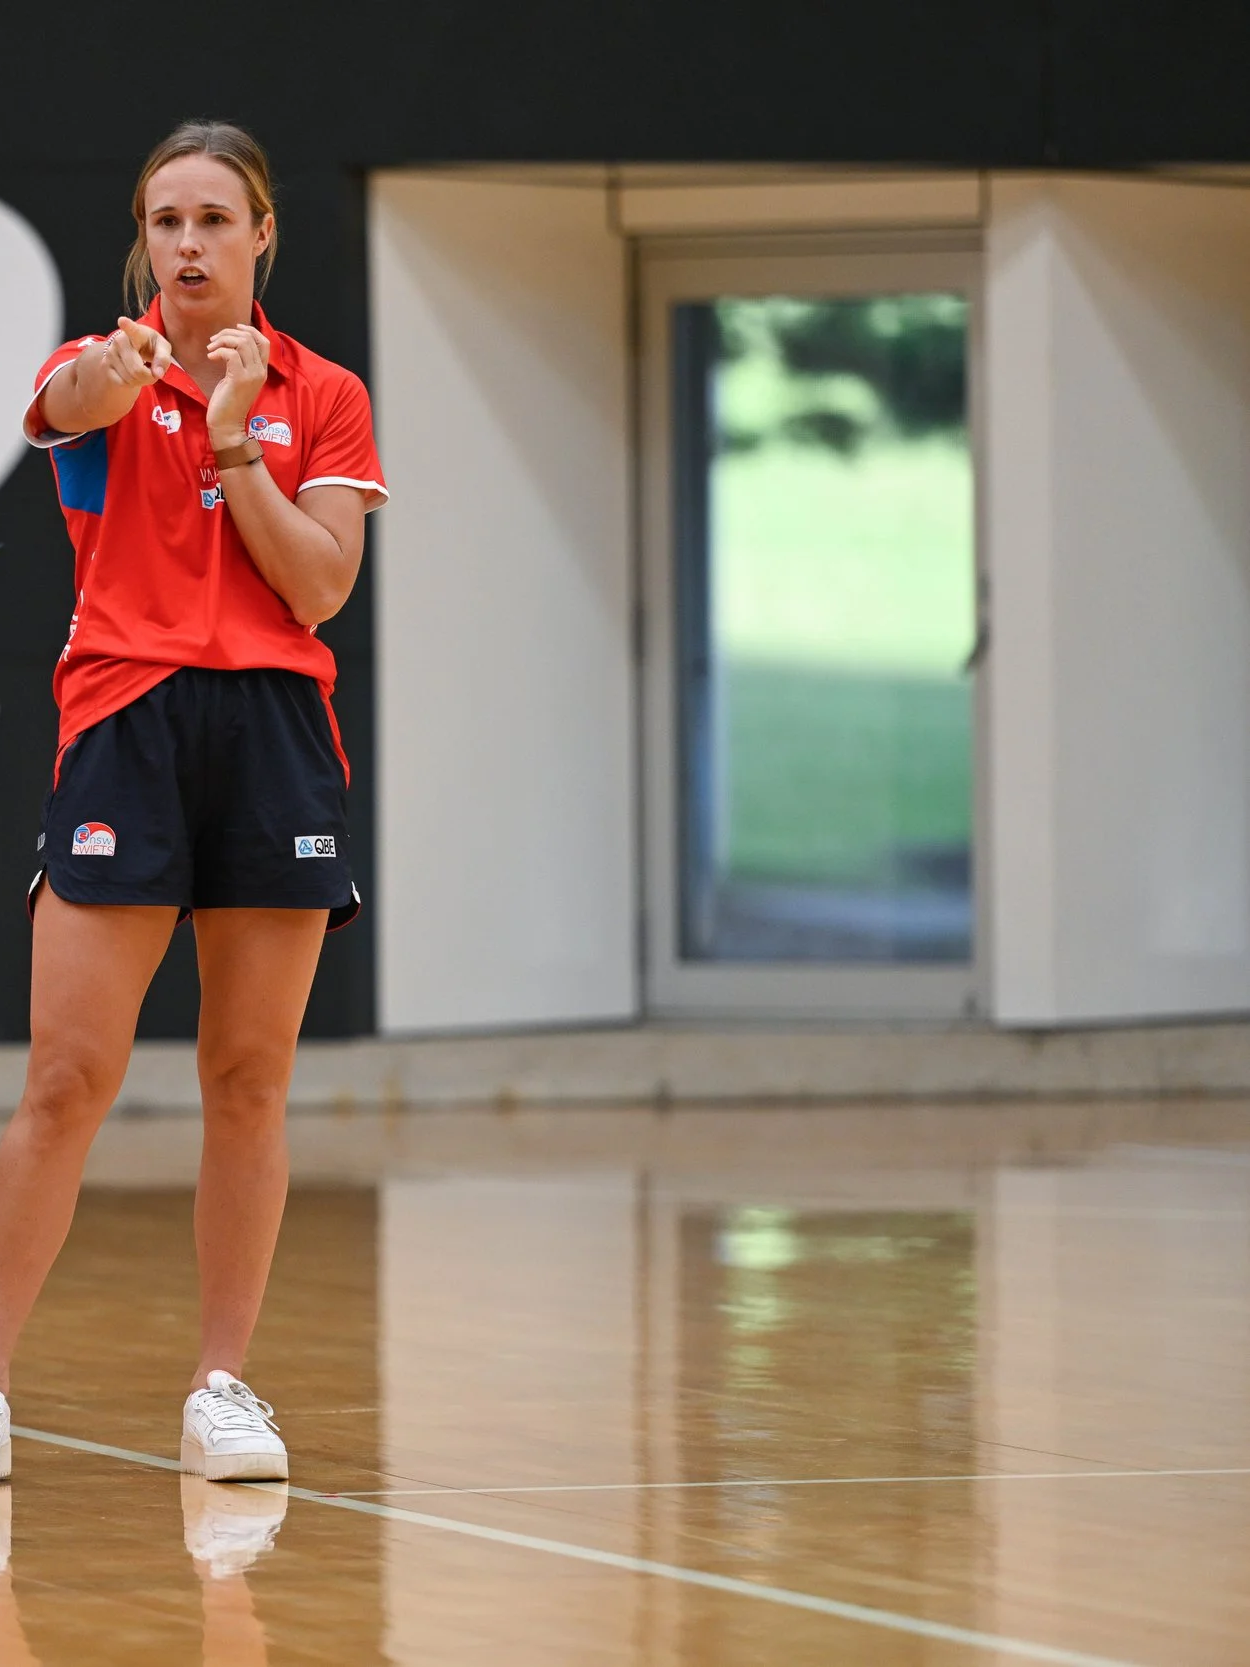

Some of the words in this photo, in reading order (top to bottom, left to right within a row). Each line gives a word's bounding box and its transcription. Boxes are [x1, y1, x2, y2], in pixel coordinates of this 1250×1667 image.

[268, 426, 290, 436] nsw
[249, 430, 290, 445] SWIFTS
[89, 836, 112, 845] nsw
[314, 838, 334, 854] QBE
[73, 844, 114, 856] SWIFTS
